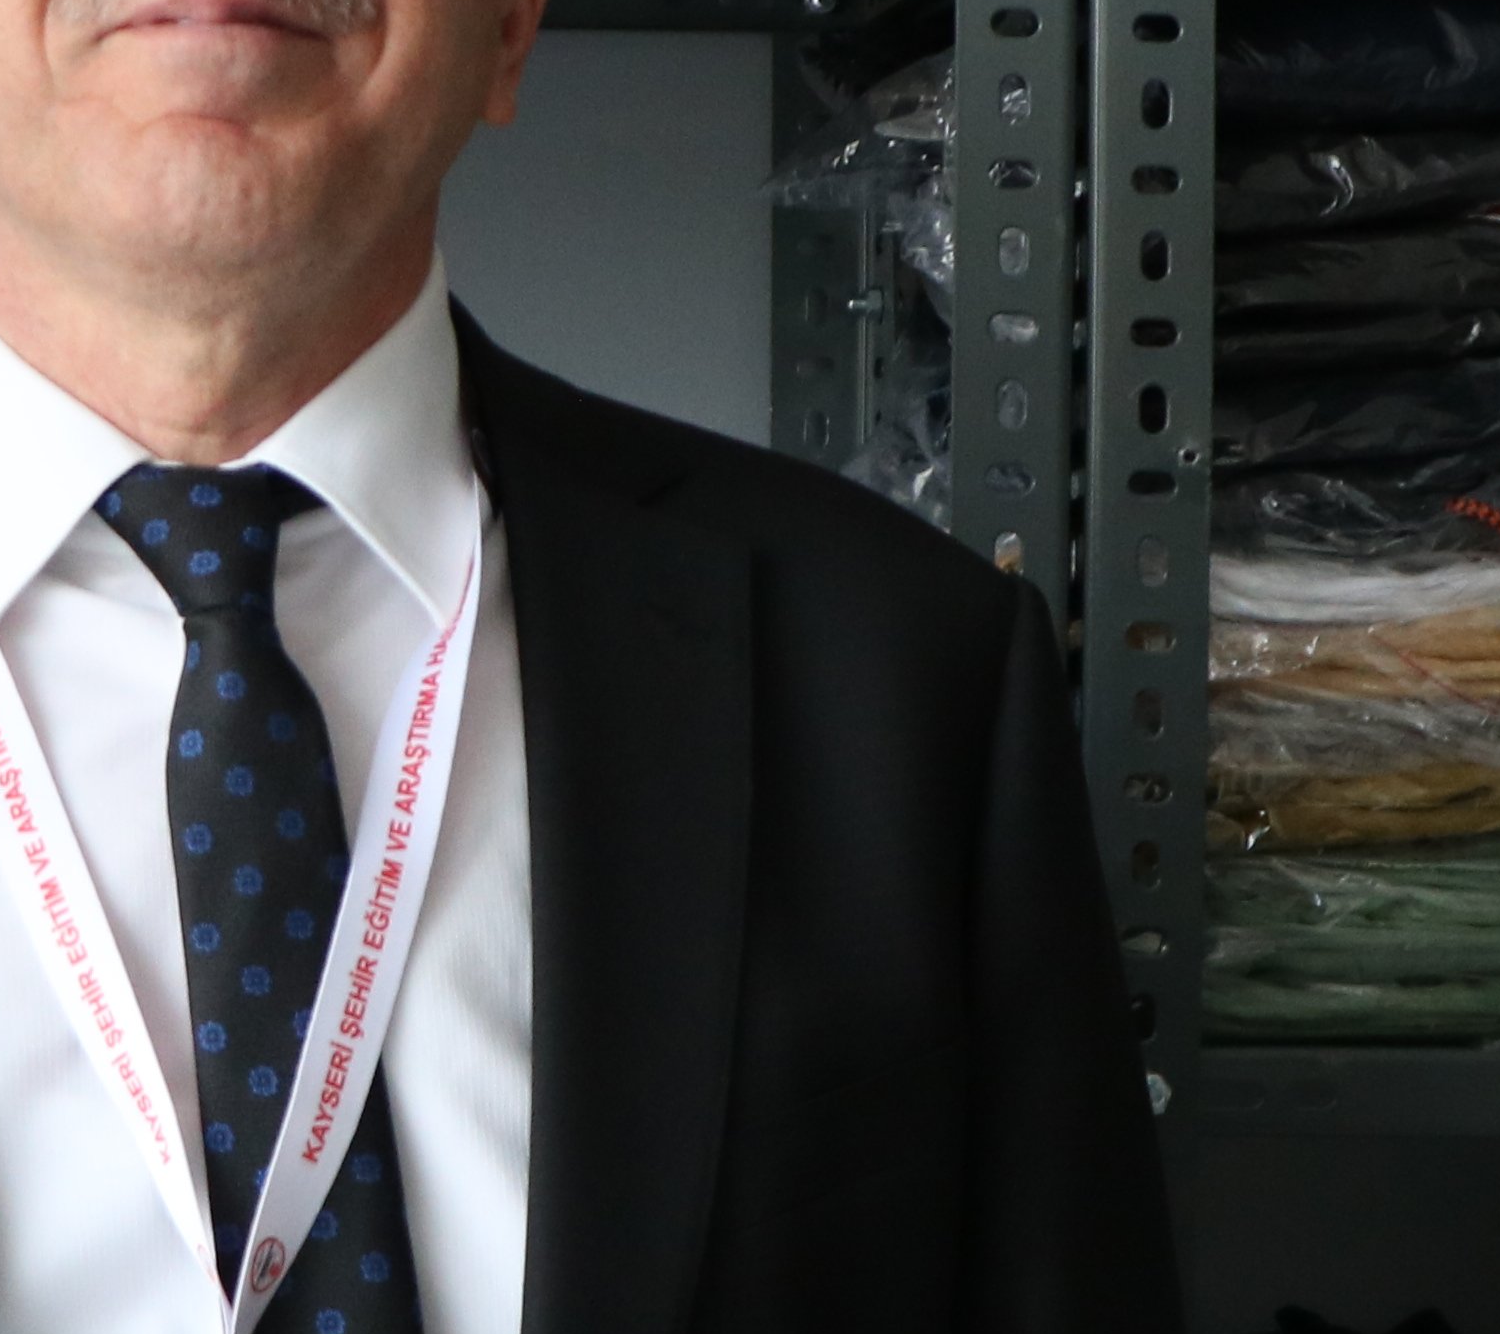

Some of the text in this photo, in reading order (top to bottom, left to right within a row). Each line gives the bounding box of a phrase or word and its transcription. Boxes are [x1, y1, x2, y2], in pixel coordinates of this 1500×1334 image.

[24, 837, 51, 876] VE
[38, 875, 89, 968] EĞİTİM
[302, 669, 442, 1165] KAYSERİ ŞEHİR EĞİTİM VE ARAŞTIRMA
[77, 966, 125, 1050] ŞEHİR
[111, 1052, 171, 1165] KAYSERİ
